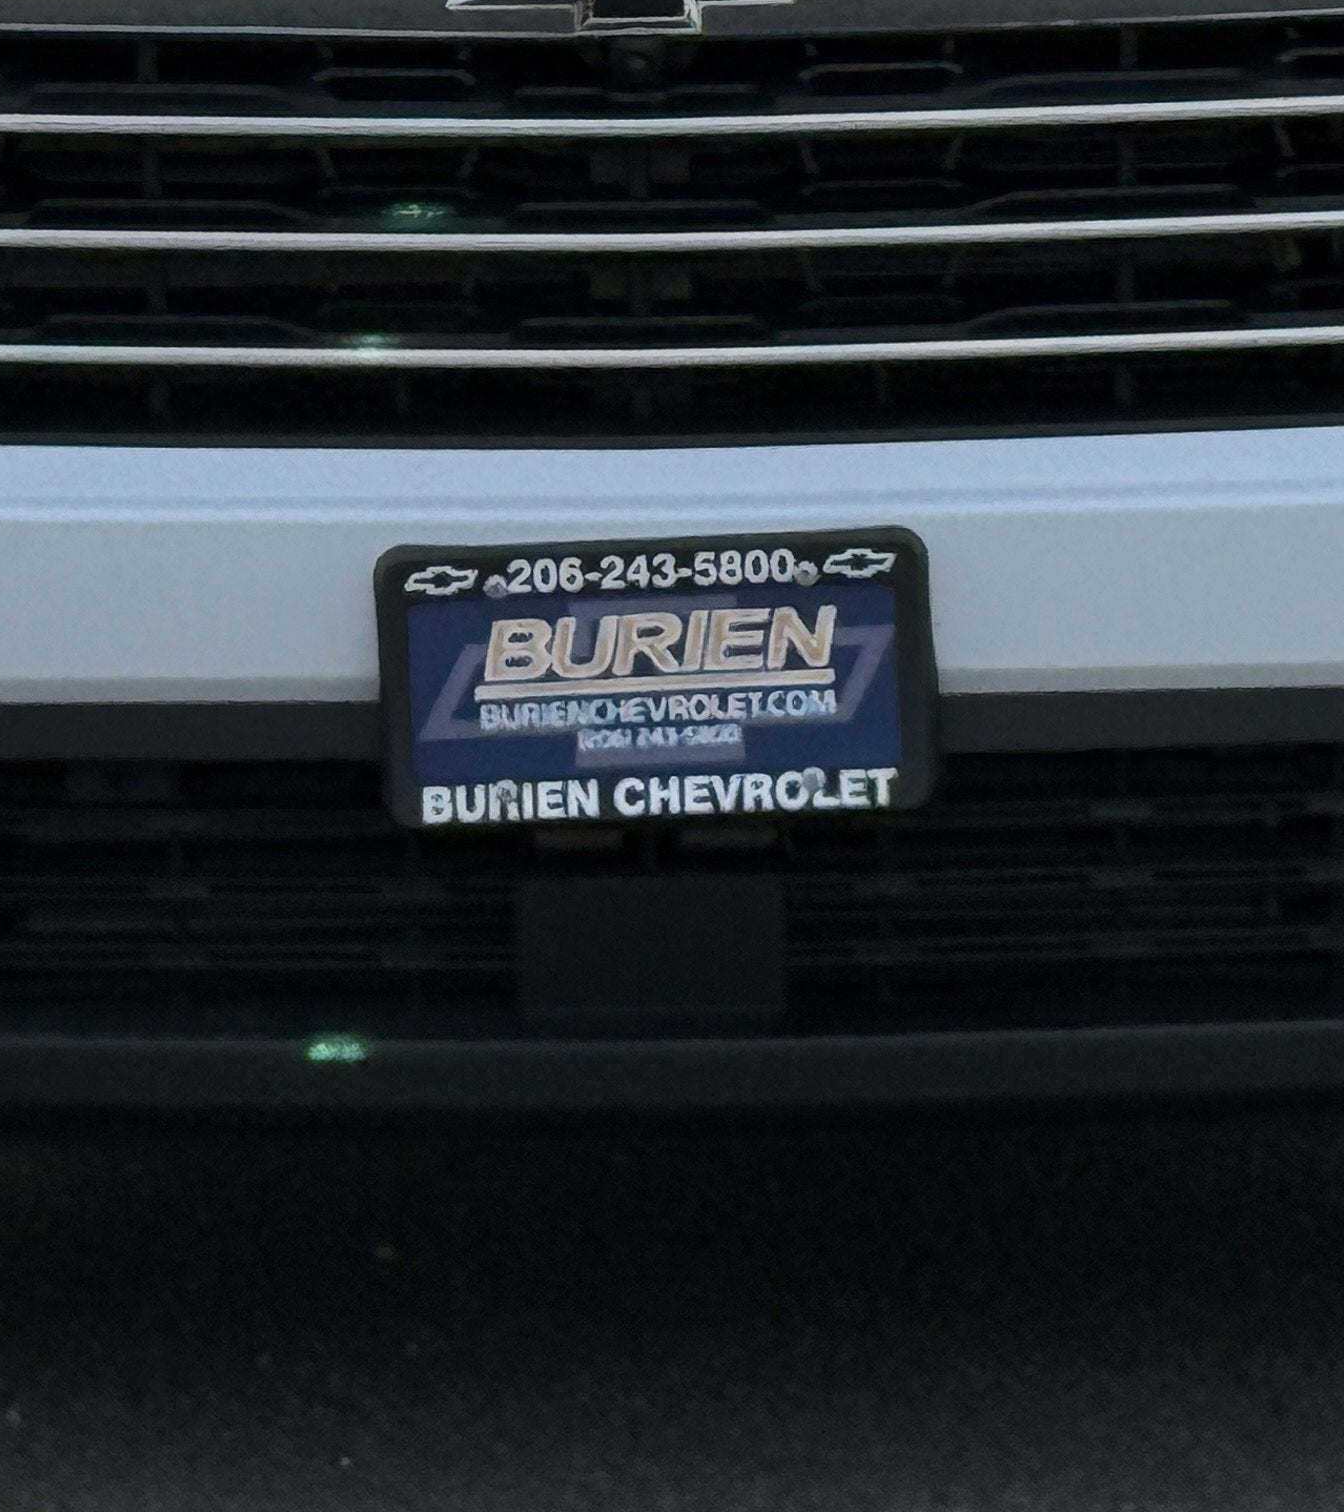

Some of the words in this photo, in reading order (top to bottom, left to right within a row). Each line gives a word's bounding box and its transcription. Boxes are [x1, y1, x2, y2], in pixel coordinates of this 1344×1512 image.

[506, 547, 796, 594] 206-243-5800
[484, 604, 838, 681] BURIEN
[480, 689, 837, 731] BURIENCHEVROLET.COM
[421, 777, 600, 824] BURIEN
[613, 767, 898, 816] CHEVROLET
